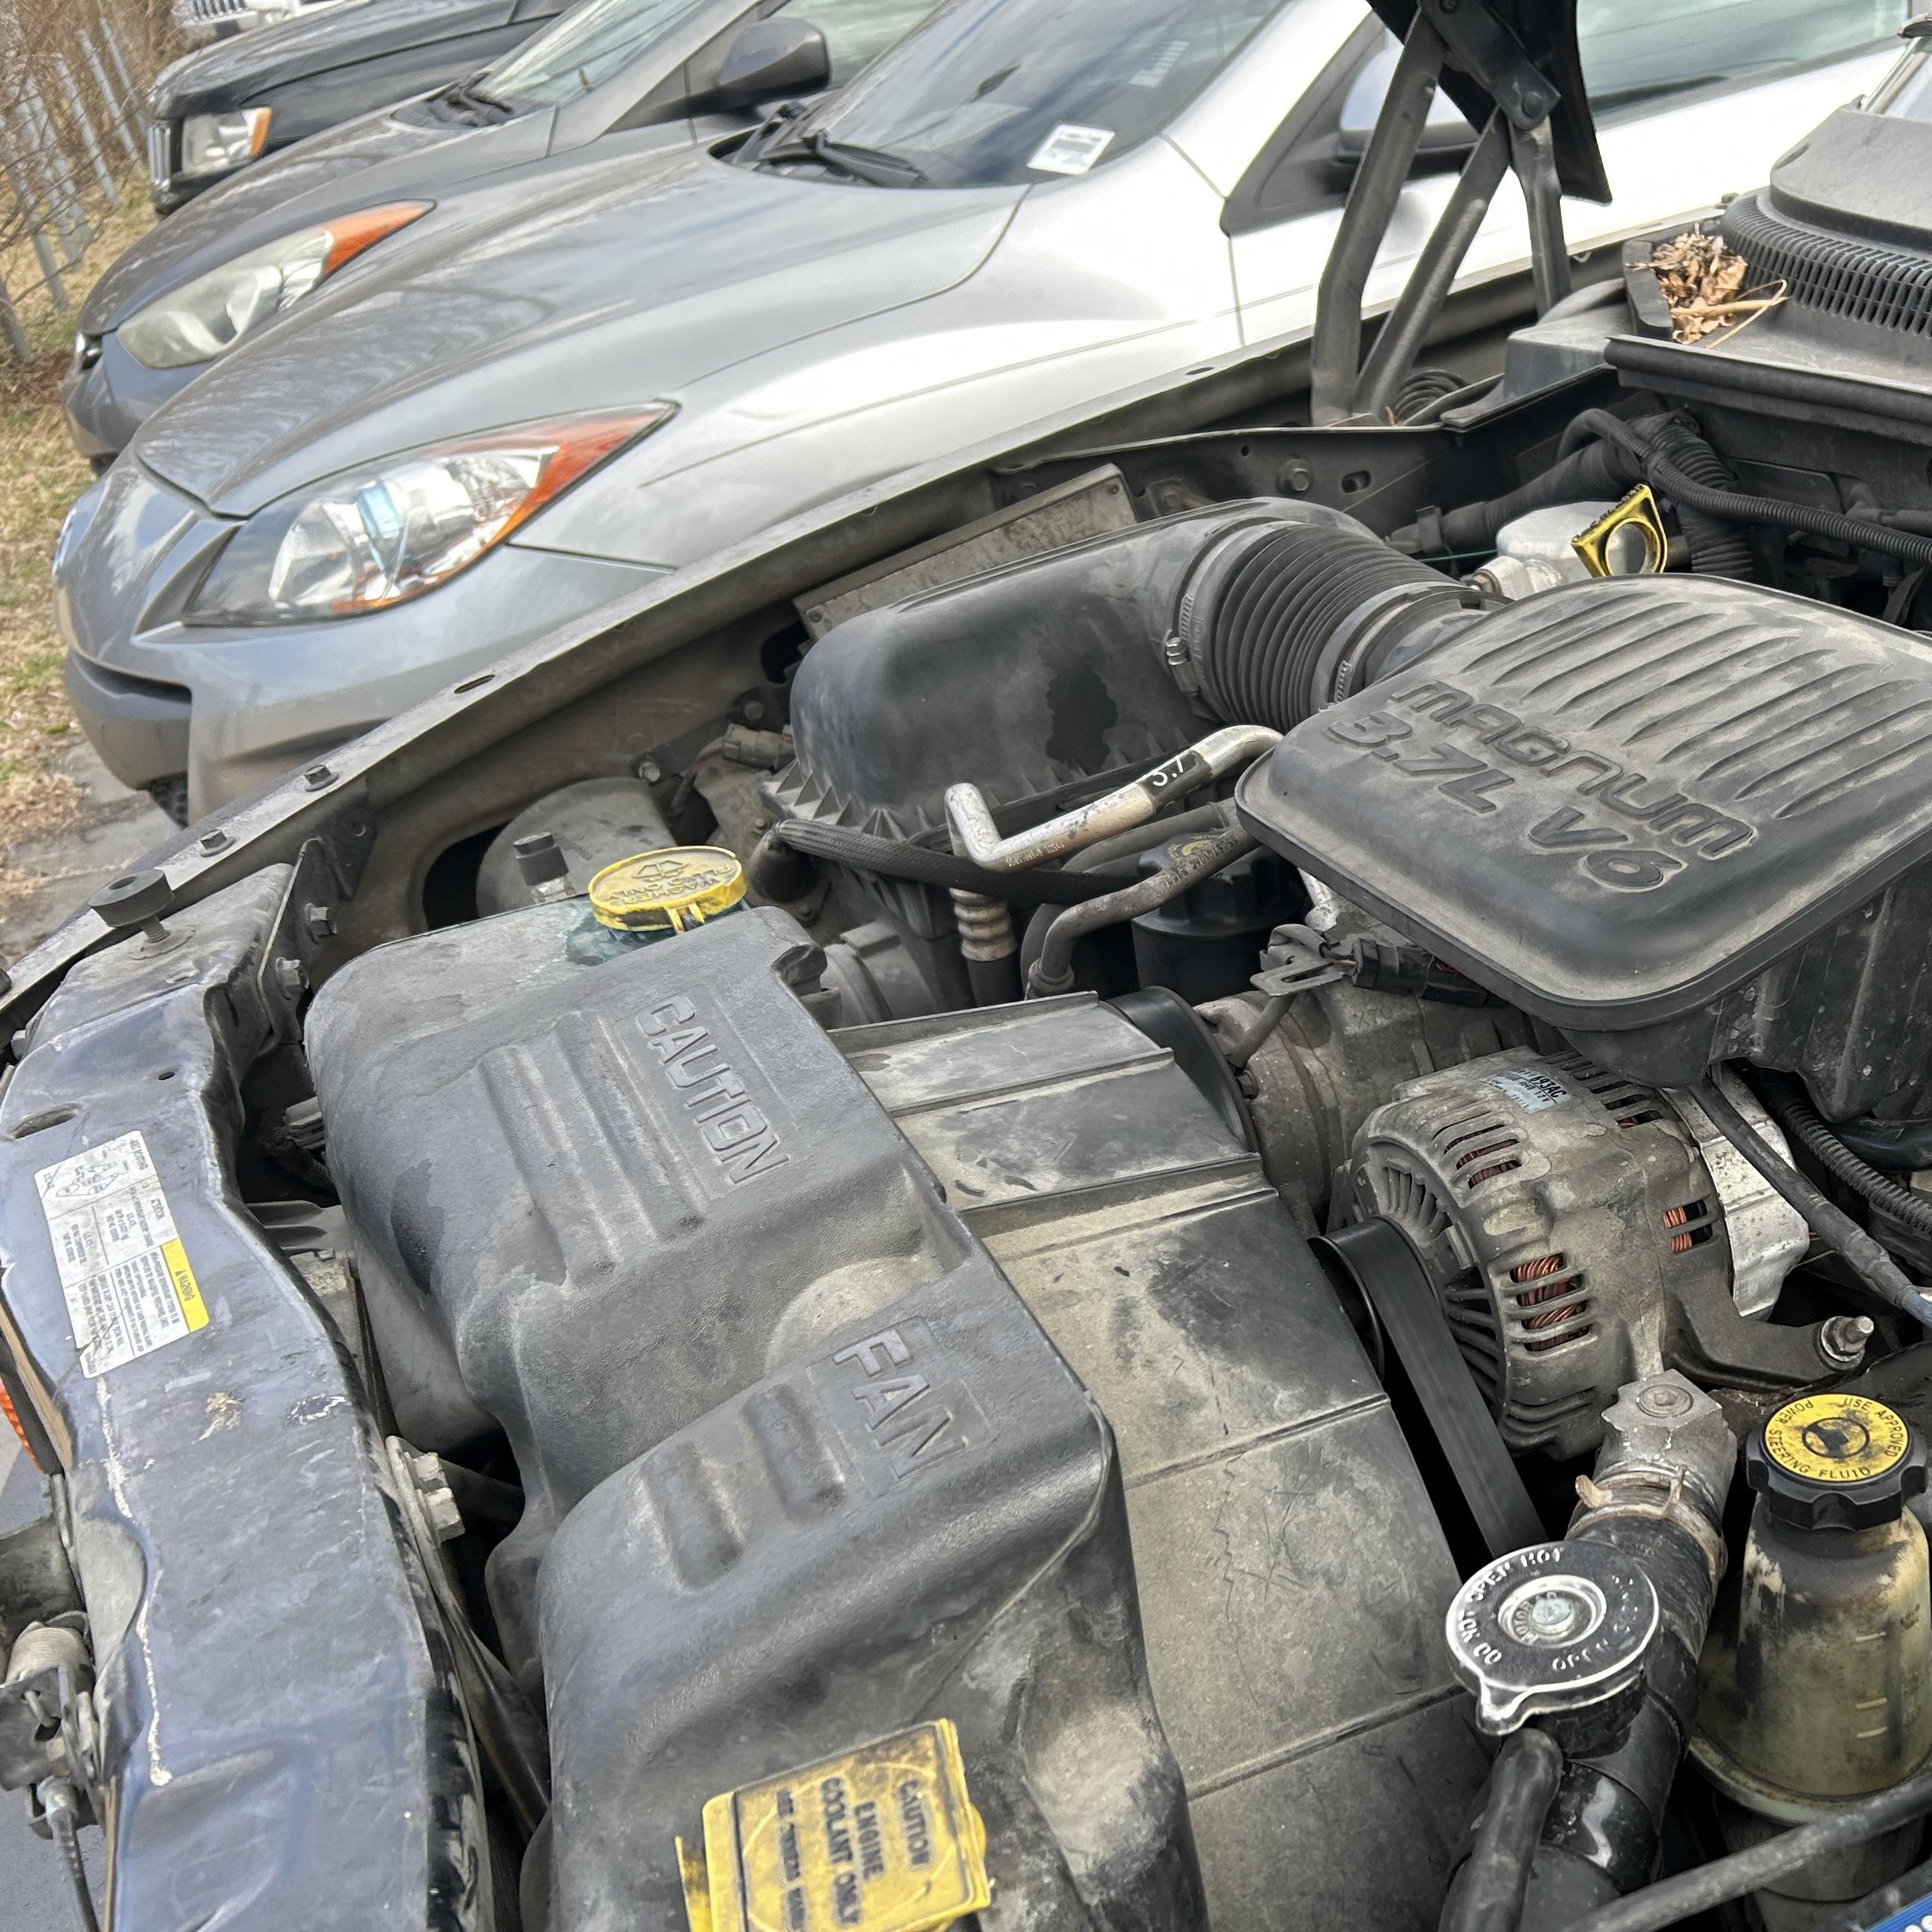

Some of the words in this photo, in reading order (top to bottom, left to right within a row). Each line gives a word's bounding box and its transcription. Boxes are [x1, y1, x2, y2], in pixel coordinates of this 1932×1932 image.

[1392, 679, 1756, 860] MAGNUM
[1328, 711, 1514, 813] 3.7L
[1529, 806, 1685, 889] V6
[623, 879, 718, 903] WASHER
[670, 864, 733, 886] FLUID
[637, 996, 788, 1183] CAUTION
[832, 1328, 969, 1479] FAN
[1775, 1399, 1814, 1424] POWER
[1843, 1397, 1872, 1411] USE
[1875, 1410, 1904, 1456] APPROVED
[1769, 1429, 1810, 1473] STEERING
[1818, 1467, 1870, 1480] FLUID
[1520, 1546, 1562, 1567] HOT
[1468, 1562, 1510, 1602] OPEN
[1458, 1609, 1479, 1643] NOT
[1473, 1642, 1502, 1664] DO
[1552, 1639, 1608, 1671] OPEN
[820, 1777, 853, 1864] COOLANT
[853, 1801, 884, 1880] ENGINE
[898, 1780, 930, 1865] CAUTION
[833, 1872, 861, 1925] ONLY
